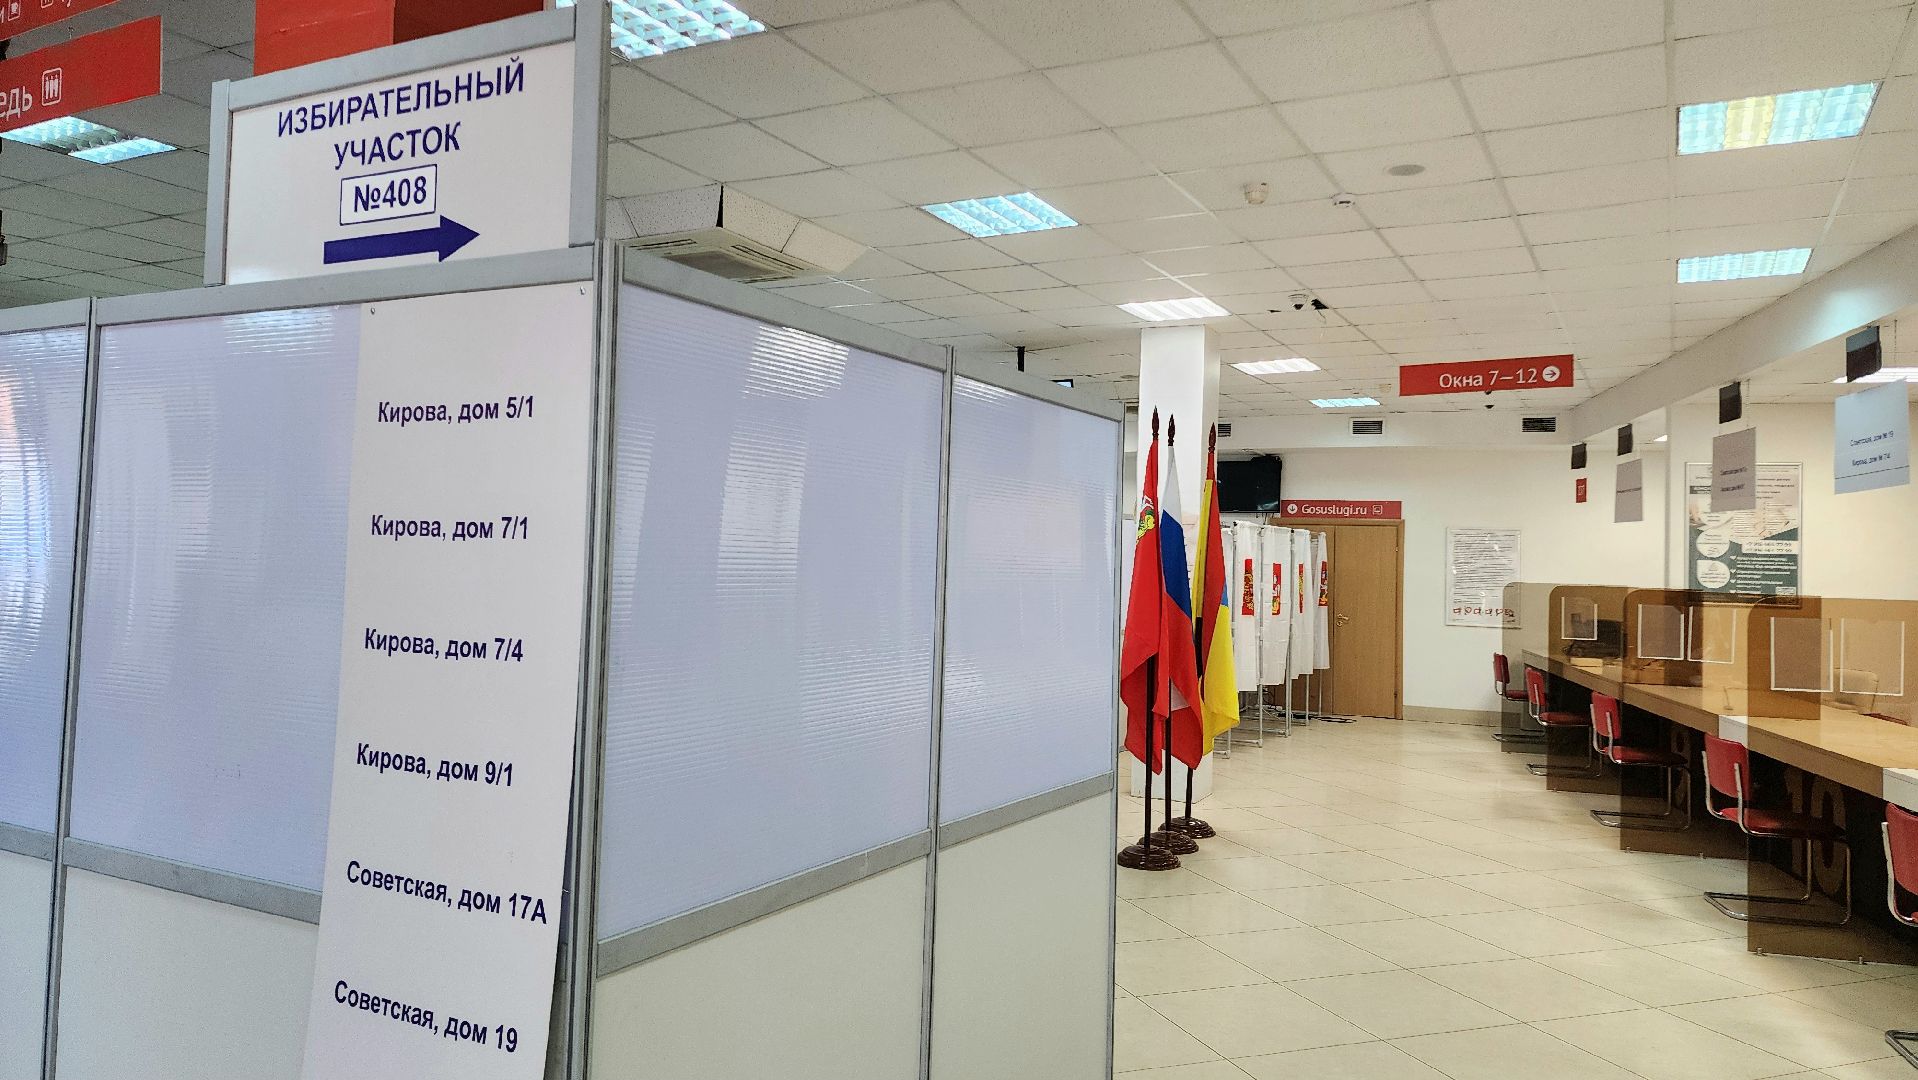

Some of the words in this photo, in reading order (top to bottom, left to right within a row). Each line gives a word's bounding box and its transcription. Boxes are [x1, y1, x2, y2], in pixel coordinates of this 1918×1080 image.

[278, 56, 524, 138] ИЗБИРАТЕЛЬНЫЙ
[334, 121, 461, 170] УЧАСТОК
[354, 176, 427, 213] №408
[1439, 373, 1483, 388] Окна
[378, 402, 452, 427] Кирова,
[457, 402, 499, 424] дом
[505, 395, 534, 419] 5/1
[371, 515, 446, 542] Кирова,
[452, 521, 493, 541] дом
[501, 516, 528, 540] 7/1
[1301, 504, 1367, 517] Gosuslugi.ru
[364, 628, 440, 659] Кирова,
[444, 639, 487, 661] дом
[494, 637, 524, 662] 7/4
[356, 743, 431, 779] Кирова,
[437, 759, 478, 782] дом
[484, 761, 513, 787] 9/1
[347, 861, 452, 907] Советская,
[457, 888, 501, 914] дом
[508, 893, 547, 924] 17А
[334, 980, 439, 1034] Советская,
[444, 1015, 488, 1045] дом
[495, 1024, 518, 1053] 19
